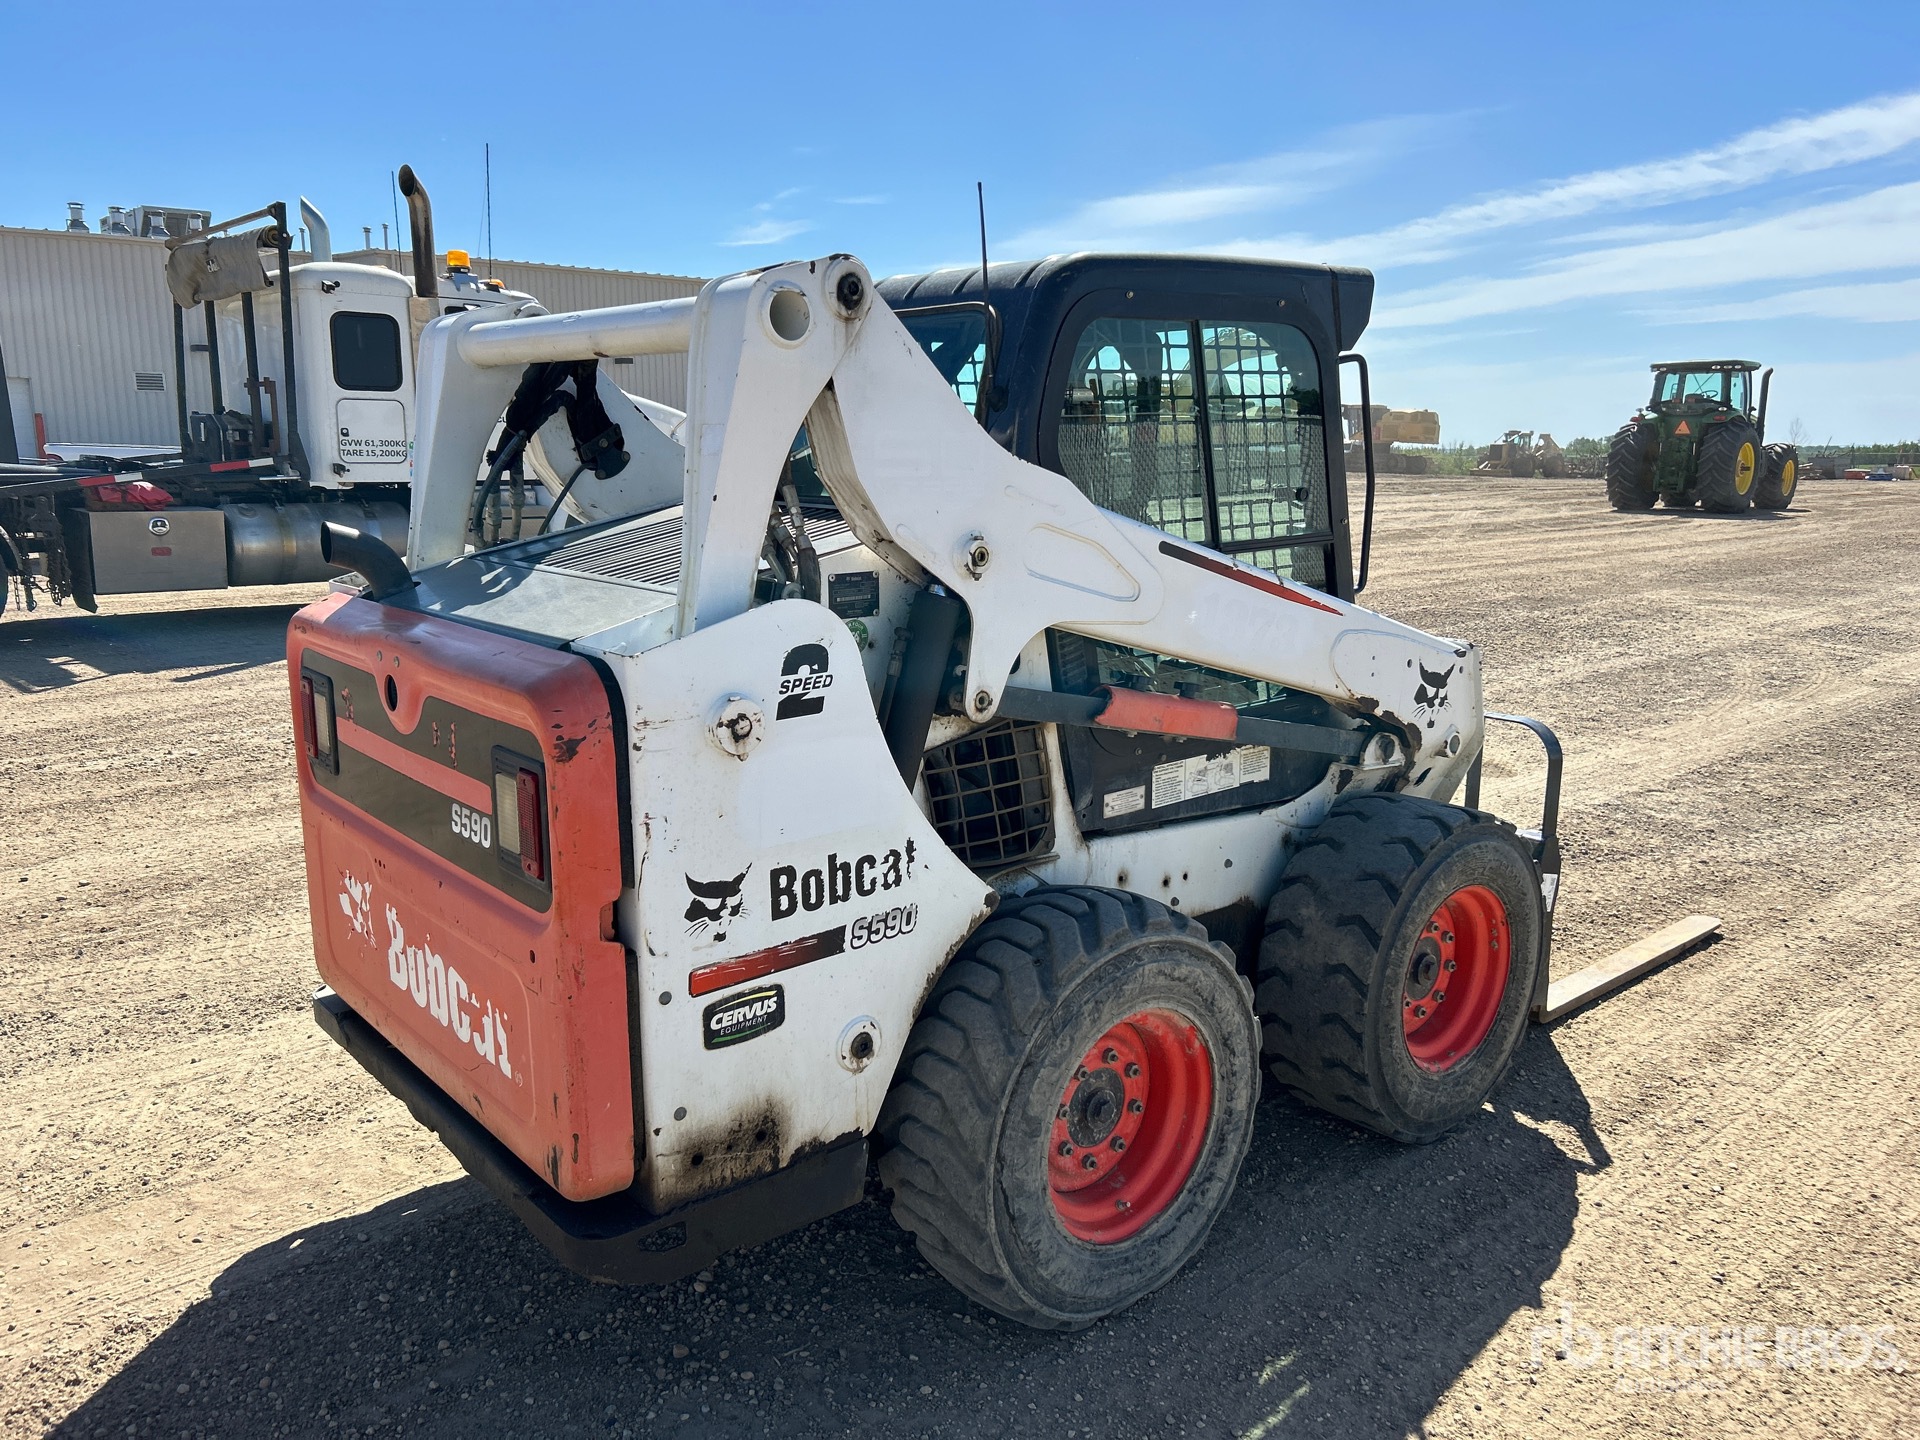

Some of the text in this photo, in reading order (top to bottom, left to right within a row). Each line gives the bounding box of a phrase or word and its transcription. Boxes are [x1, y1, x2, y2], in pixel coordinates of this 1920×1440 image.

[340, 439, 363, 447] GVW
[340, 449, 408, 458] TARE 15,200KG
[779, 674, 833, 695] SPEED
[451, 803, 491, 848] S590
[850, 902, 918, 950] S590
[710, 996, 777, 1031] CERVUS
[720, 1015, 768, 1036] EQUIPMENT
